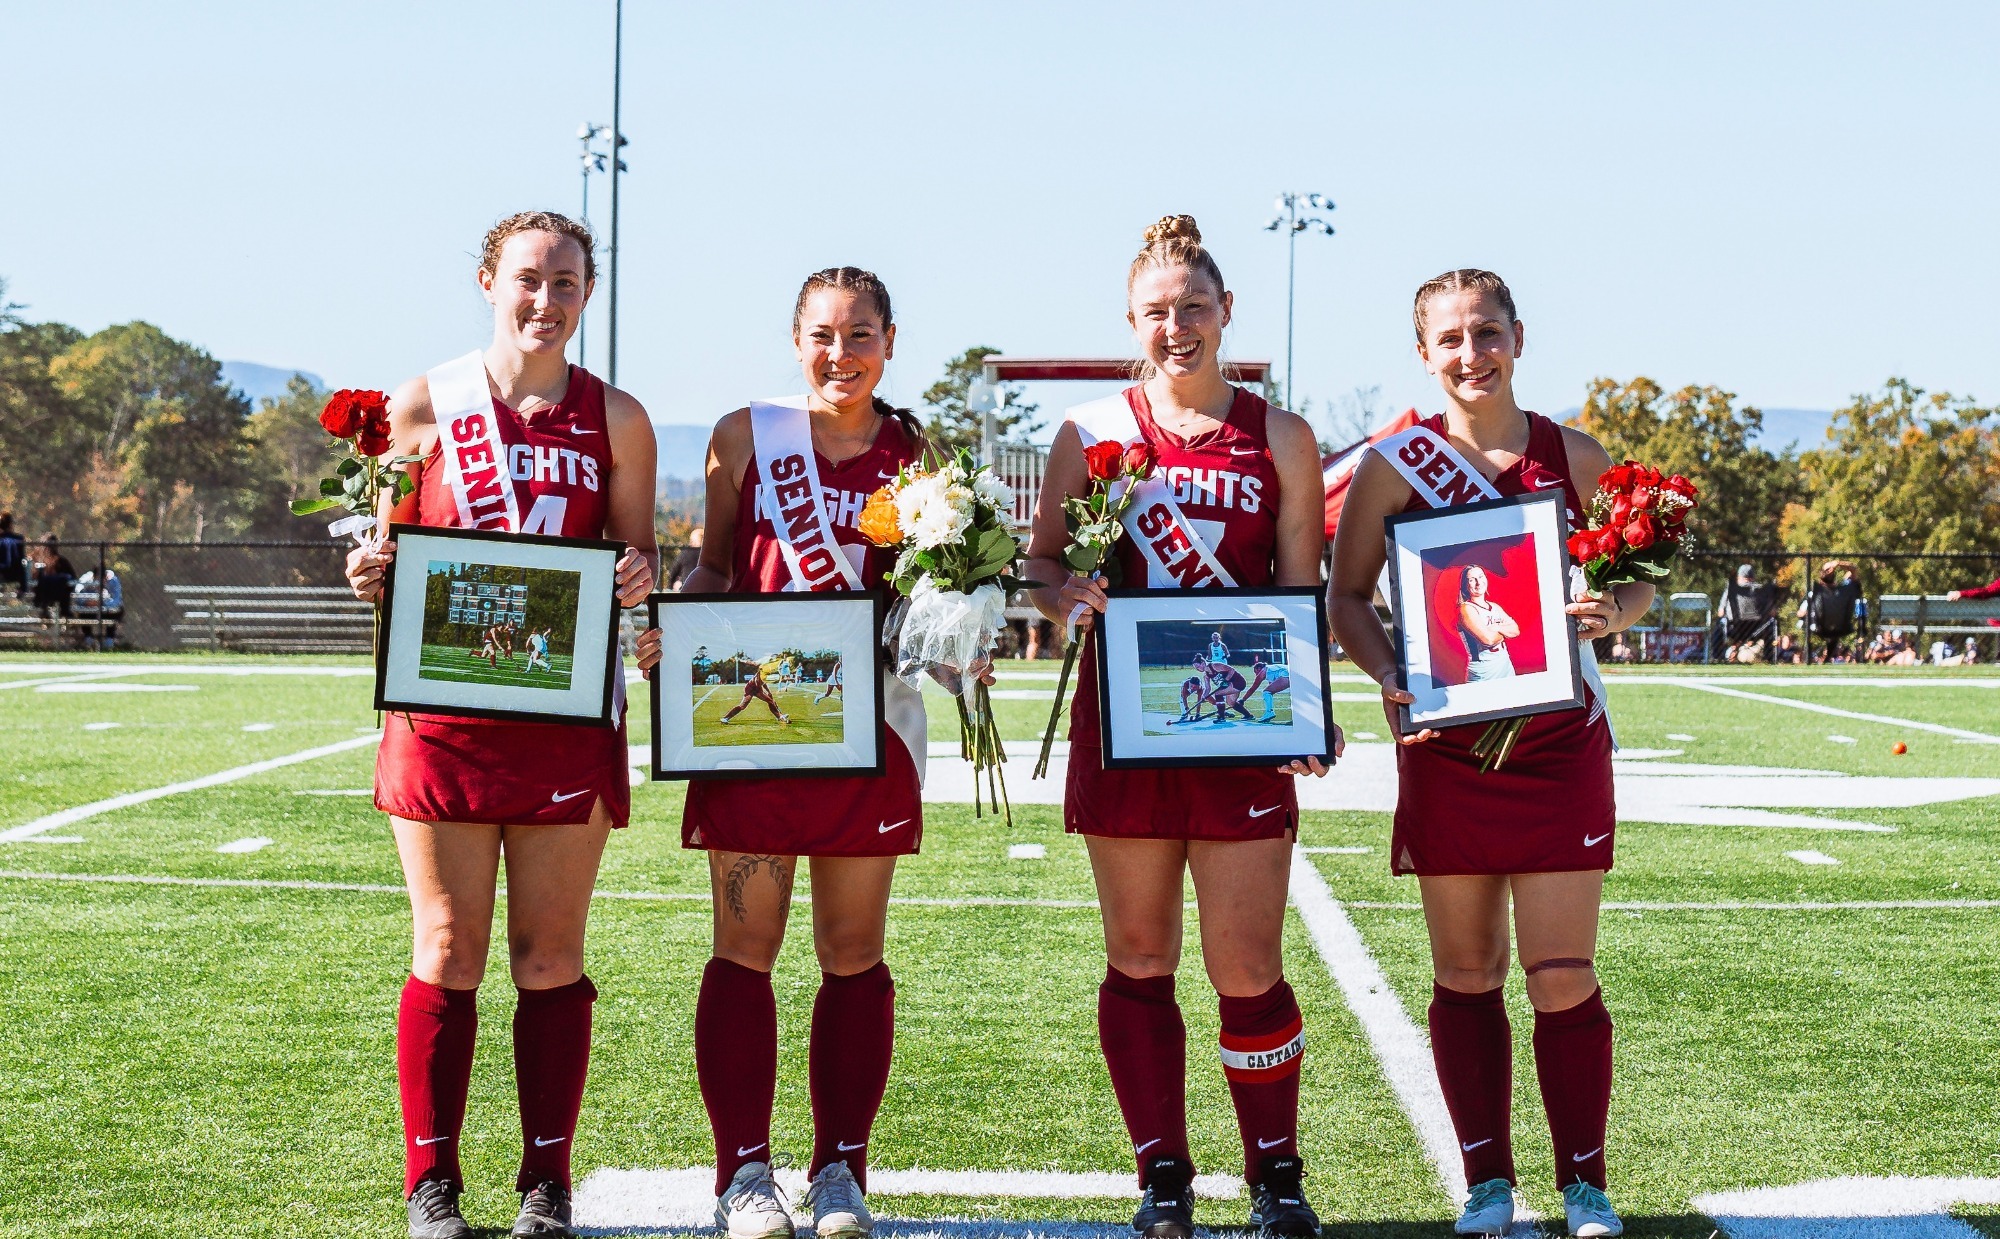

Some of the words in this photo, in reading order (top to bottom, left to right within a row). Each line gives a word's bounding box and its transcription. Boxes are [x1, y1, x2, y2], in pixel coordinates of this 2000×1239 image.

[1398, 436, 1493, 504] SEN
[1137, 502, 1224, 588] SEN
[1247, 1037, 1302, 1068] CAPTAIN
